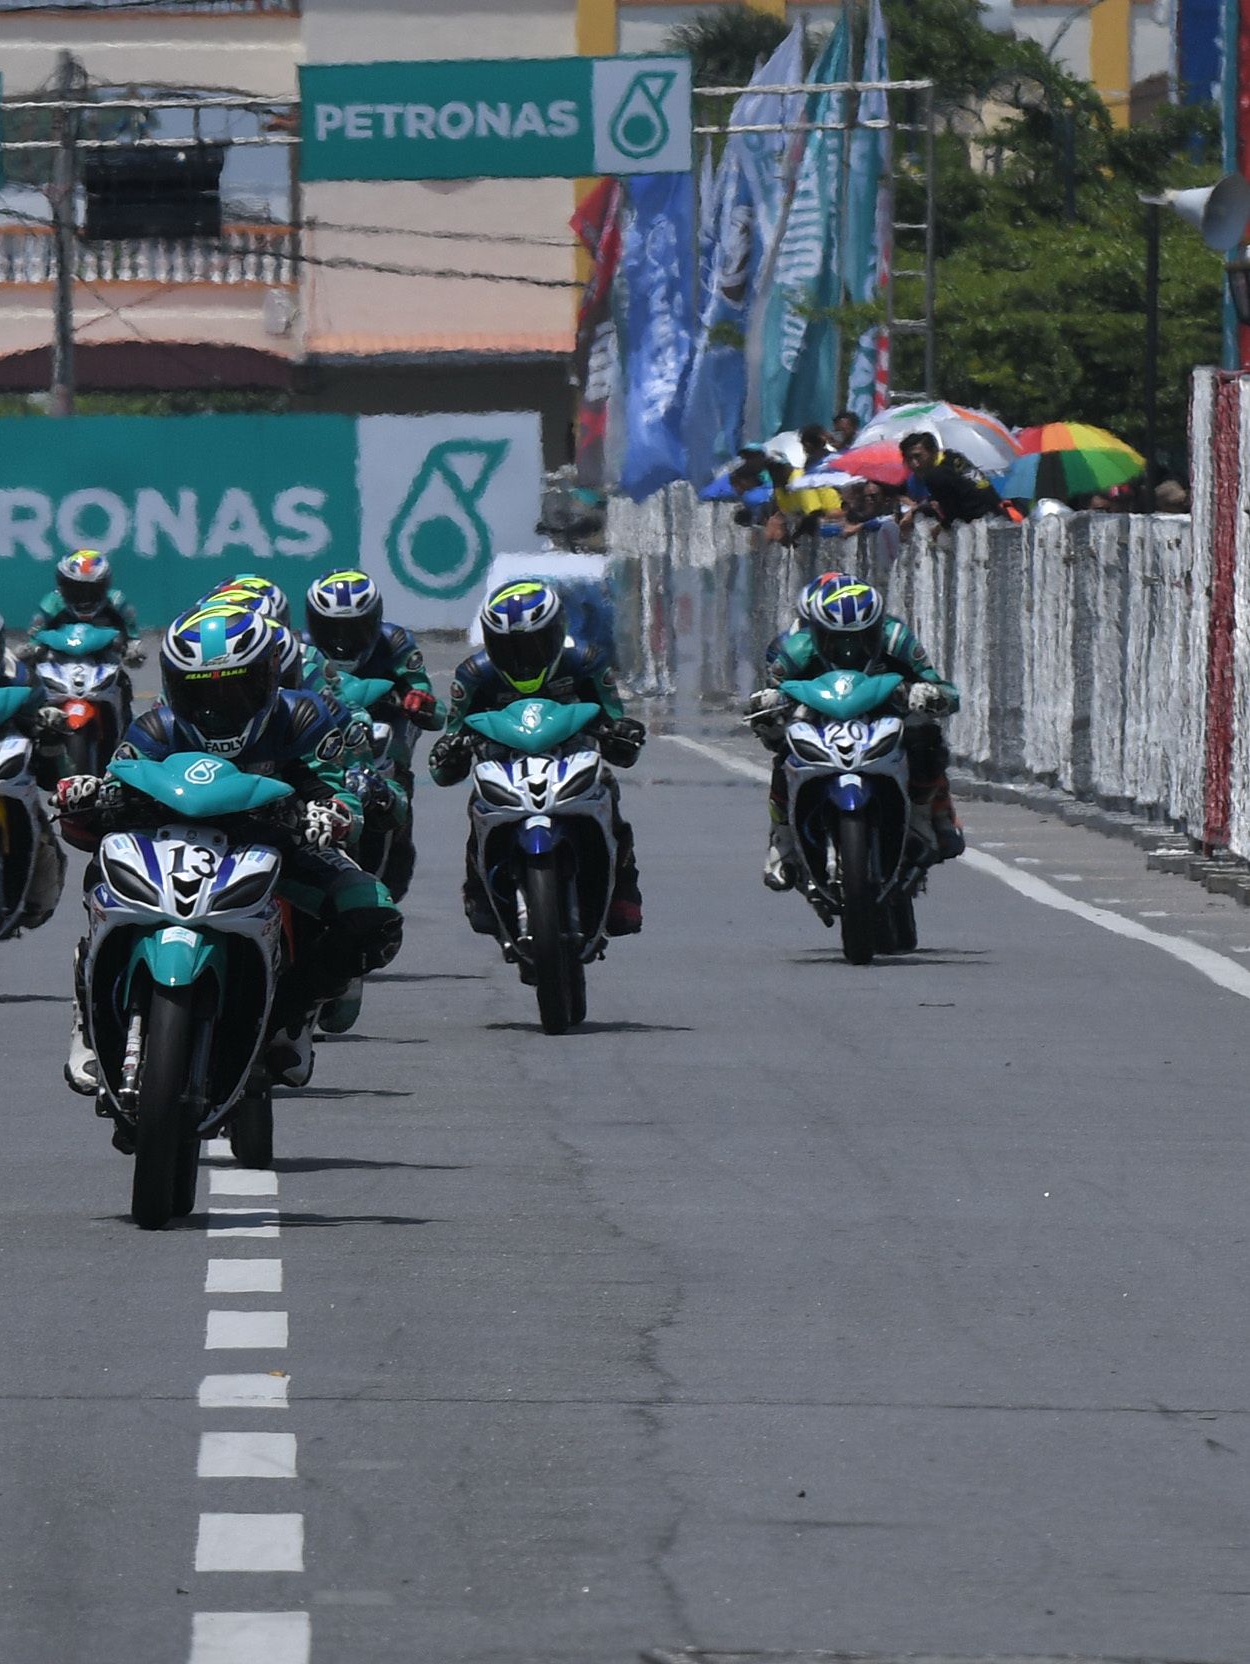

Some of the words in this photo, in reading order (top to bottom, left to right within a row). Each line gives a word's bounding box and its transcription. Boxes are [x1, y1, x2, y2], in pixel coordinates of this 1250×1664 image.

[315, 100, 579, 141] PETRONAS
[205, 737, 245, 753] FADLY
[828, 720, 864, 745] 20
[517, 754, 556, 782] 17
[167, 844, 218, 879] 13
